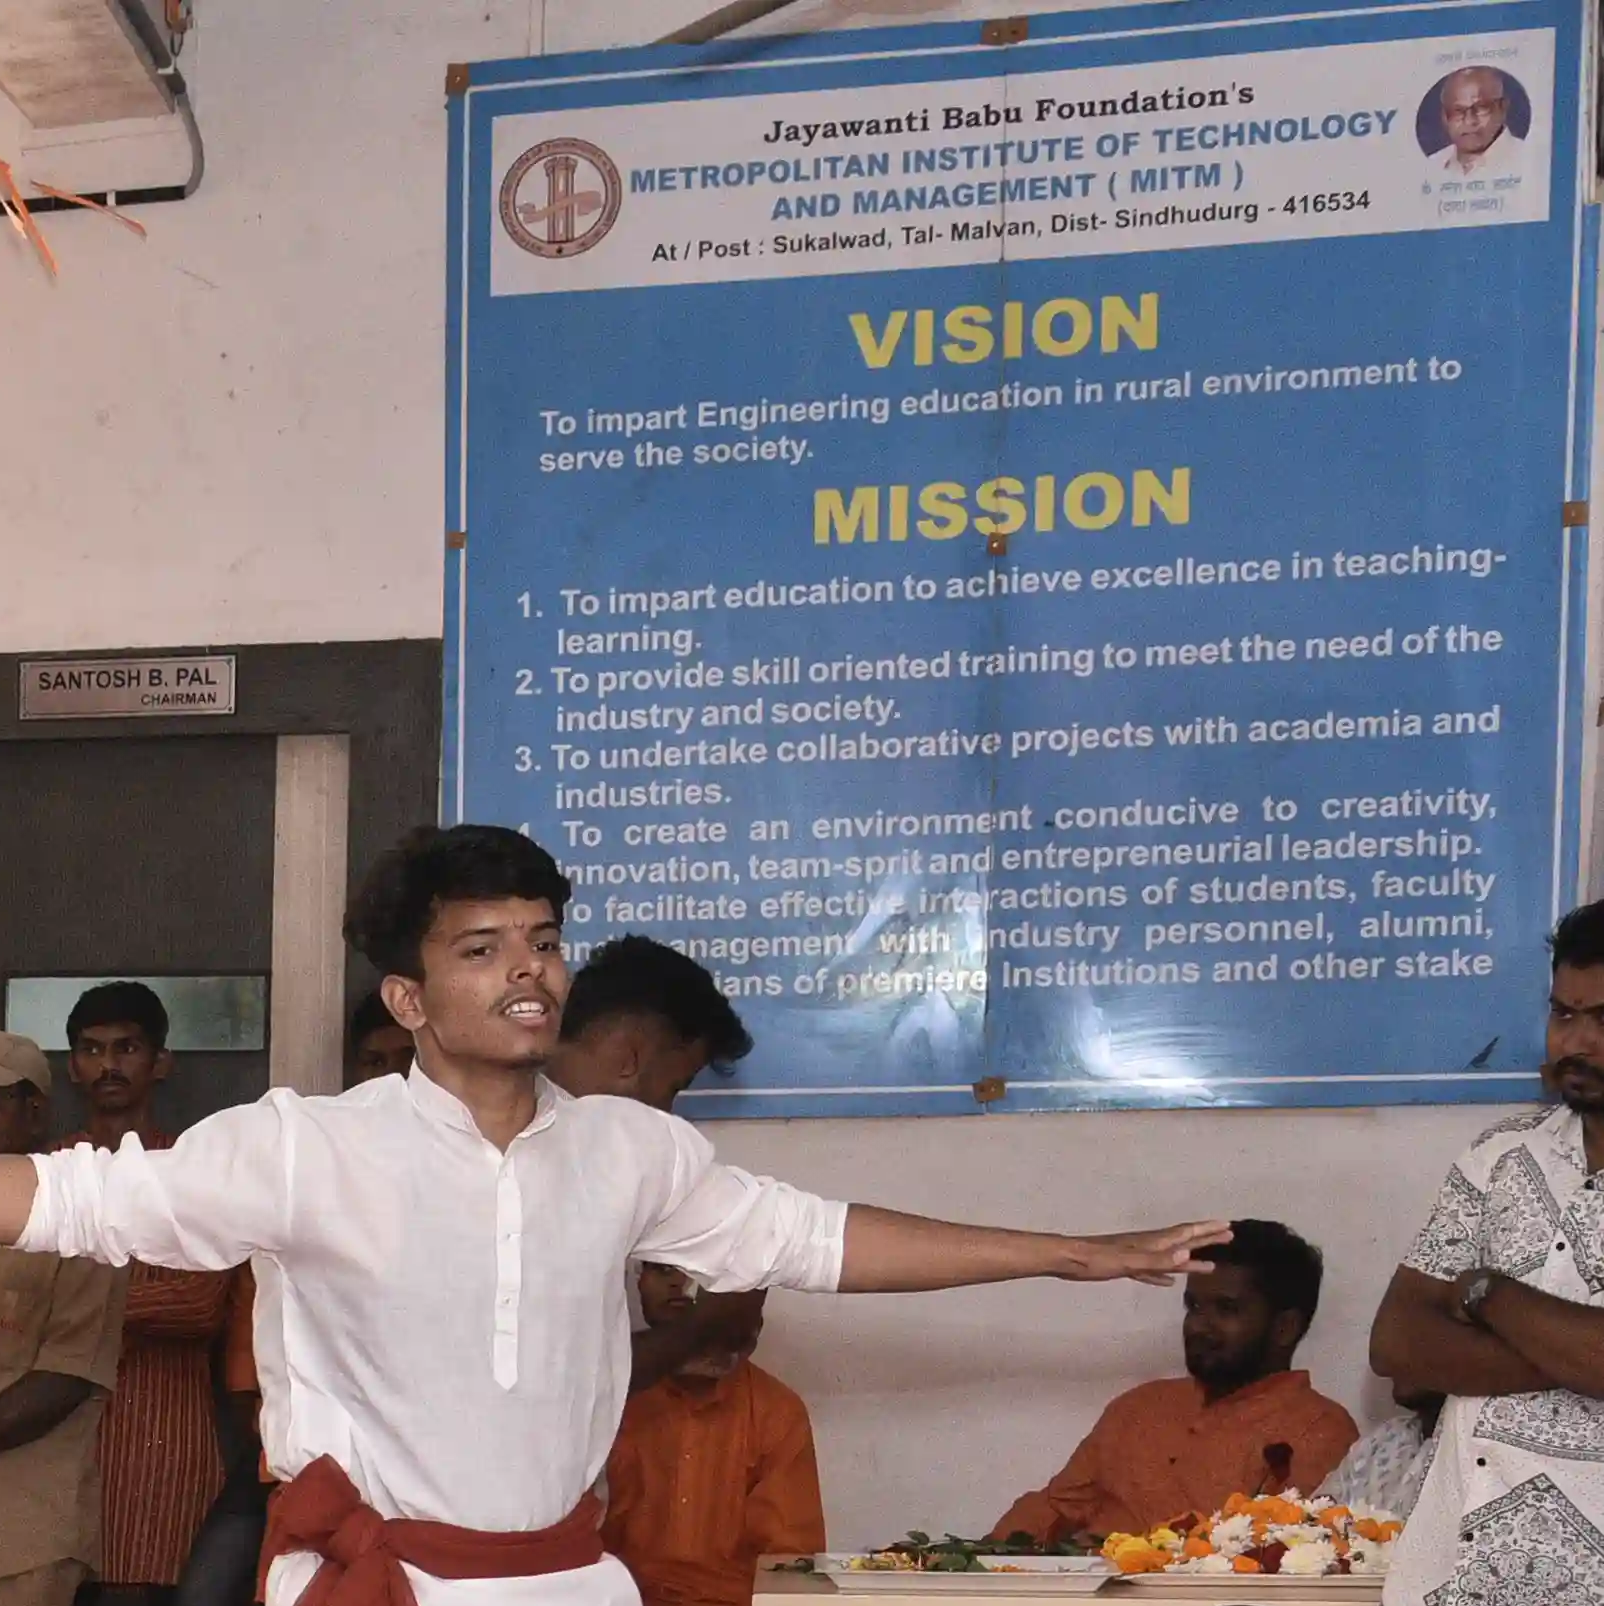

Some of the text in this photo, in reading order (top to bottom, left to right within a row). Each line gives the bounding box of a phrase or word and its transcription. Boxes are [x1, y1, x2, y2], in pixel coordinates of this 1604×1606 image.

[764, 82, 1254, 146] Jayawanti Babu Foundation's
[631, 109, 1398, 193] METROPOLITAN INSTITUTE OF TECHNOLOGY
[771, 163, 1221, 221] AND MANAGEMENT MITM
[652, 190, 1371, 262] At Post Sukalwad, Tal- Malvan, Dist- Sindhudurg 416534
[849, 293, 1159, 369] VISION
[540, 356, 1462, 437] To impart Engineering education in rural environment to
[539, 436, 814, 472] serve the society.
[814, 468, 1190, 544] MISSION
[517, 544, 1507, 618] 1. To impart education to achieve excellence in teaching-
[515, 624, 1504, 698] 2. To provide skill oriented training to meet the need of the
[557, 626, 703, 656] learning.
[39, 668, 216, 691] SANTOSH B. PAL
[141, 692, 216, 706] CHAIRMAN
[514, 705, 1500, 772] 3. To undertake collaborative projects with academia and
[556, 695, 901, 735] industry and society.
[556, 782, 731, 811] industries.
[561, 791, 1496, 847] To create an environment conducive to creativity,
[749, 847, 923, 881] team-sprit
[930, 846, 991, 874] and
[1002, 834, 1273, 873] entrepreneurial
[1282, 828, 1482, 861] leadership.
[605, 892, 747, 923] facilitate
[760, 887, 905, 919] effective
[1141, 877, 1177, 907] of
[1189, 872, 1356, 905] students,
[1372, 869, 1495, 902] faculty
[880, 908, 1492, 955] with personnel, alumni,
[793, 964, 829, 993] of
[837, 967, 987, 999] premiere
[1002, 953, 1200, 988] Institutions
[1213, 954, 1277, 982] and
[1290, 952, 1385, 980] other
[1395, 951, 1492, 978] stake
